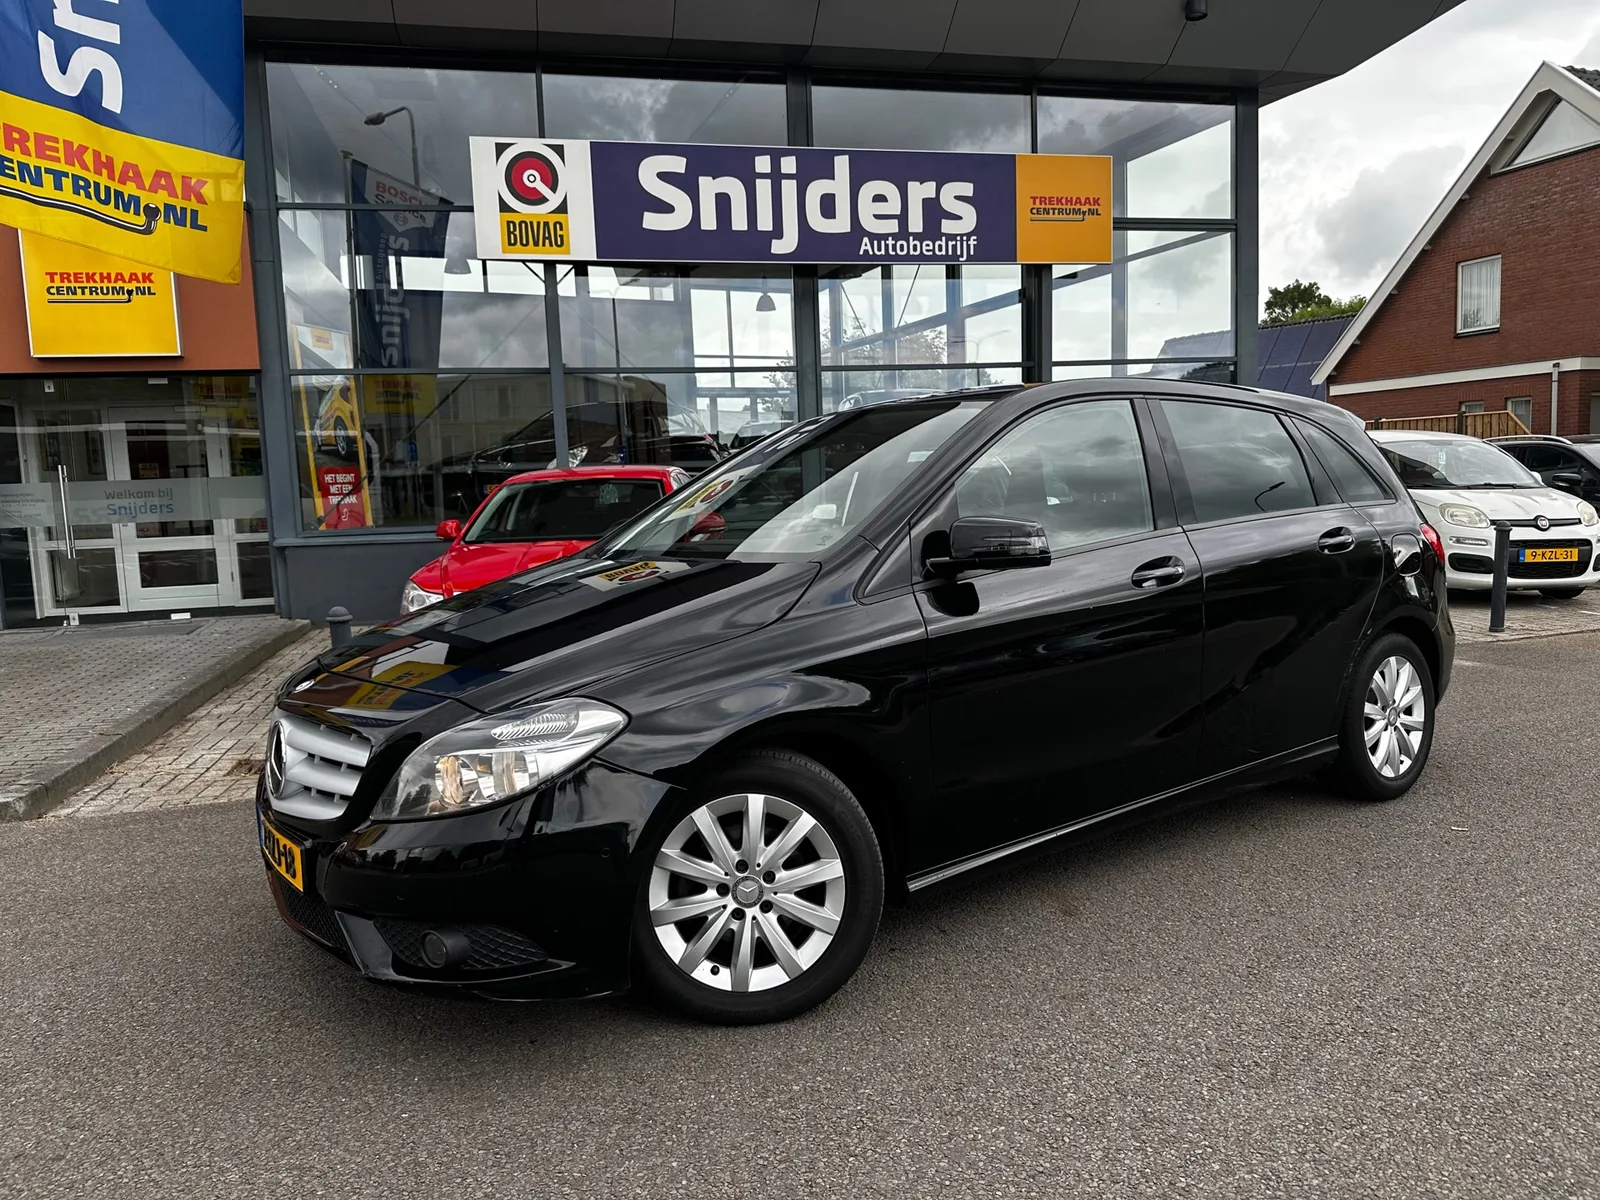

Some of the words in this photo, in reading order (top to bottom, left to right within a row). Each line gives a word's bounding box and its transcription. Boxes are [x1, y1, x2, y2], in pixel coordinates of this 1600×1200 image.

[0, 122, 209, 206] REKHAAK
[638, 154, 977, 255] Snijders
[1030, 196, 1101, 207] TREKHAAK
[506, 220, 565, 248] BOVAG
[859, 235, 978, 262] Autobedrijf
[45, 271, 155, 284] TREKHAAK
[324, 474, 336, 483] HET
[336, 473, 355, 483] BEGINT
[104, 489, 154, 500] Welkom
[158, 487, 173, 501] bij
[329, 484, 342, 494] MET
[106, 501, 174, 519] Snijders
[1531, 550, 1573, 560] 9-KZL-31
